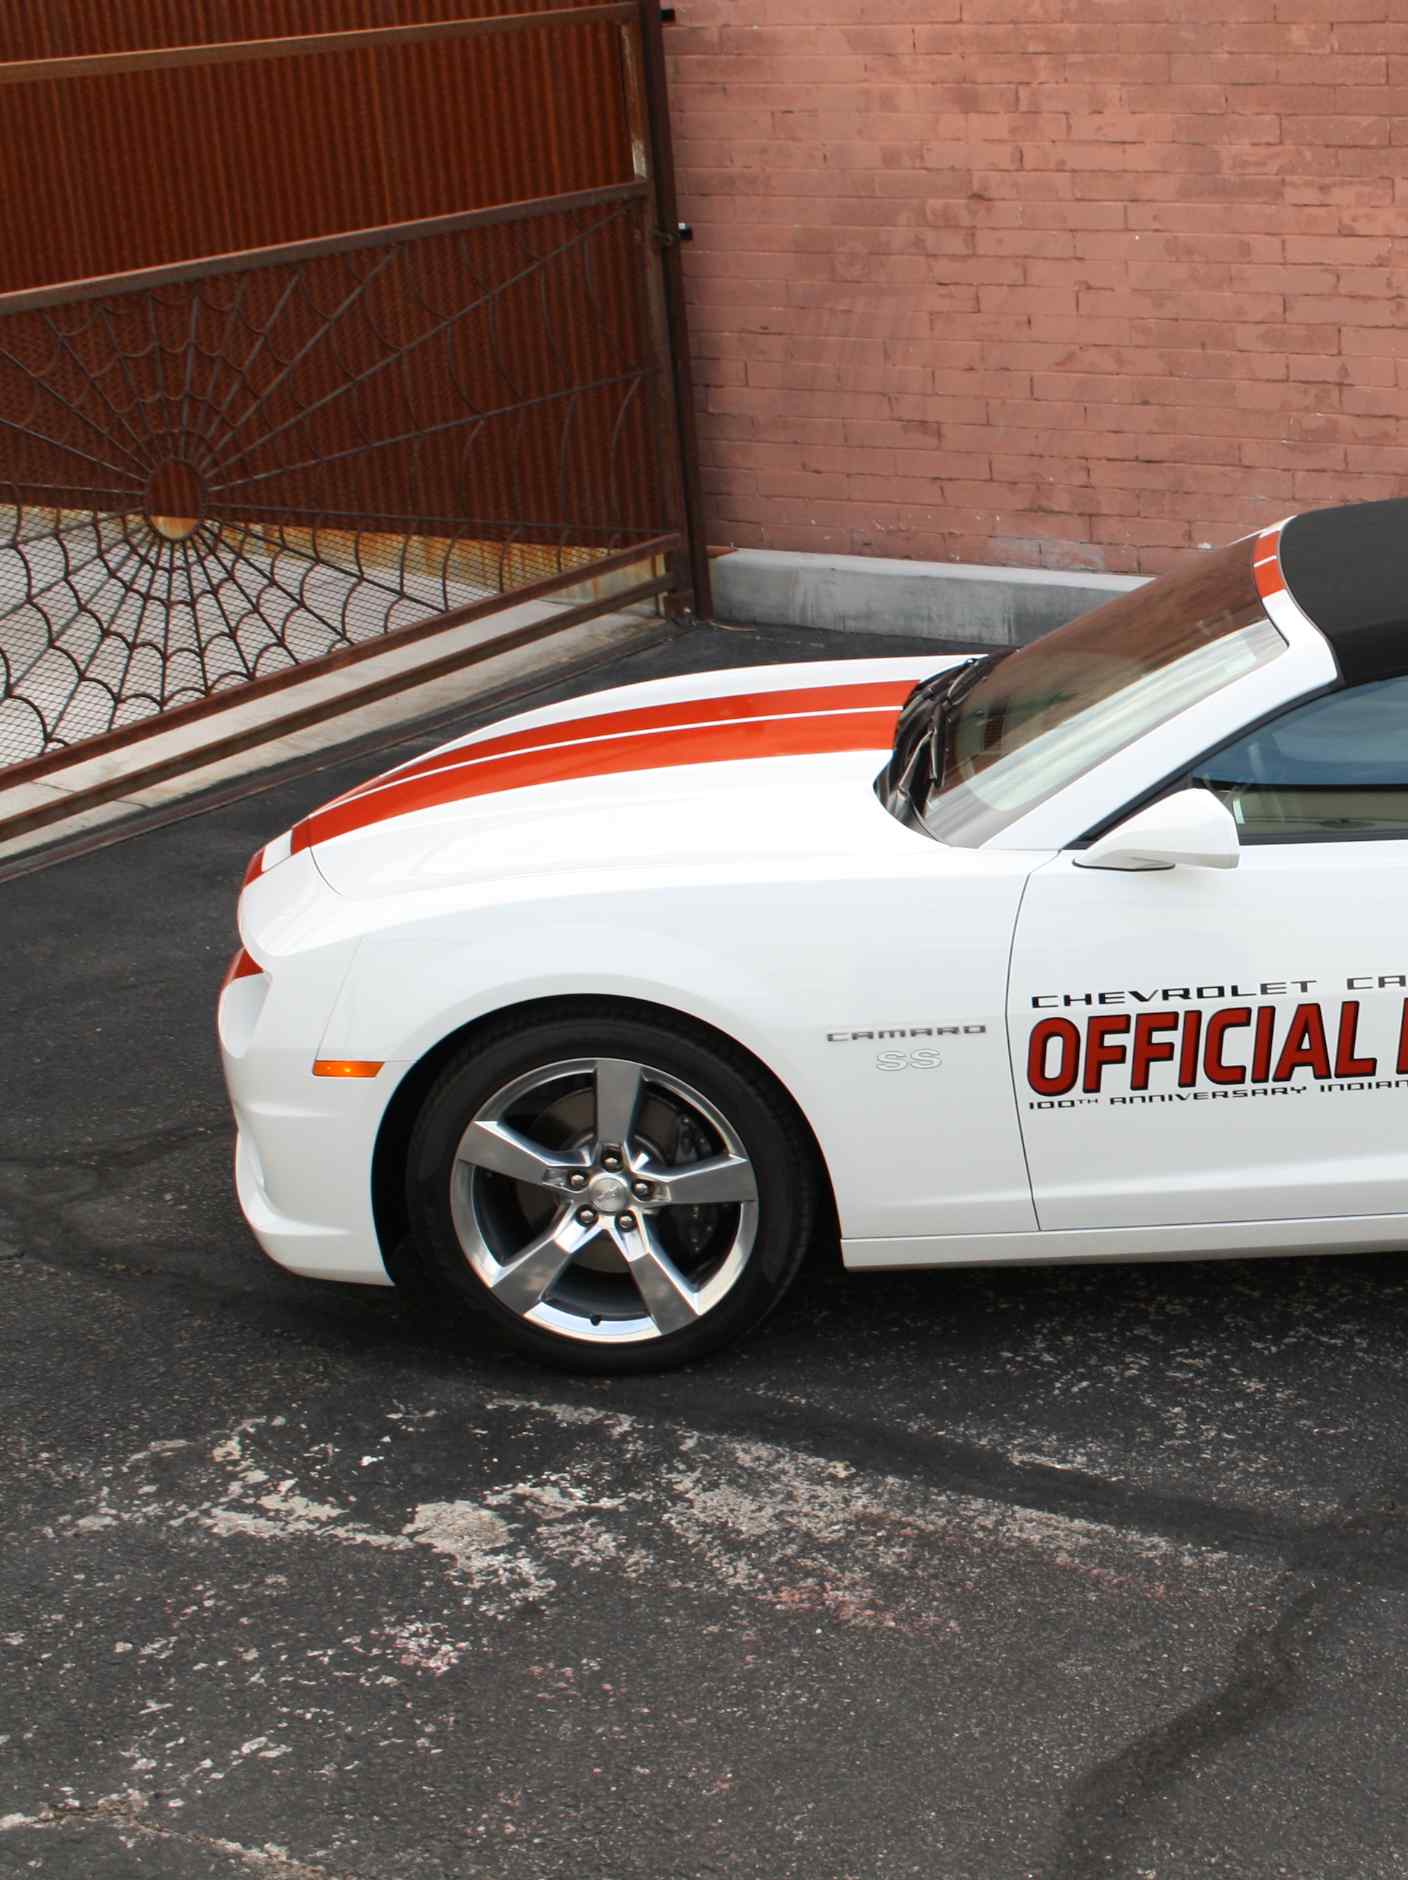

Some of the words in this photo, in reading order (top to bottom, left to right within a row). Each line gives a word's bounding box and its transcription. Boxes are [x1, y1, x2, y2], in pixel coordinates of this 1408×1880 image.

[1032, 979, 1317, 1009] CHEVROLET
[827, 1024, 987, 1042] CAMARO
[876, 1048, 943, 1071] SS
[1027, 1001, 1377, 1097] OFFICIAL
[1109, 1086, 1307, 1105] ANNIVERSARY
